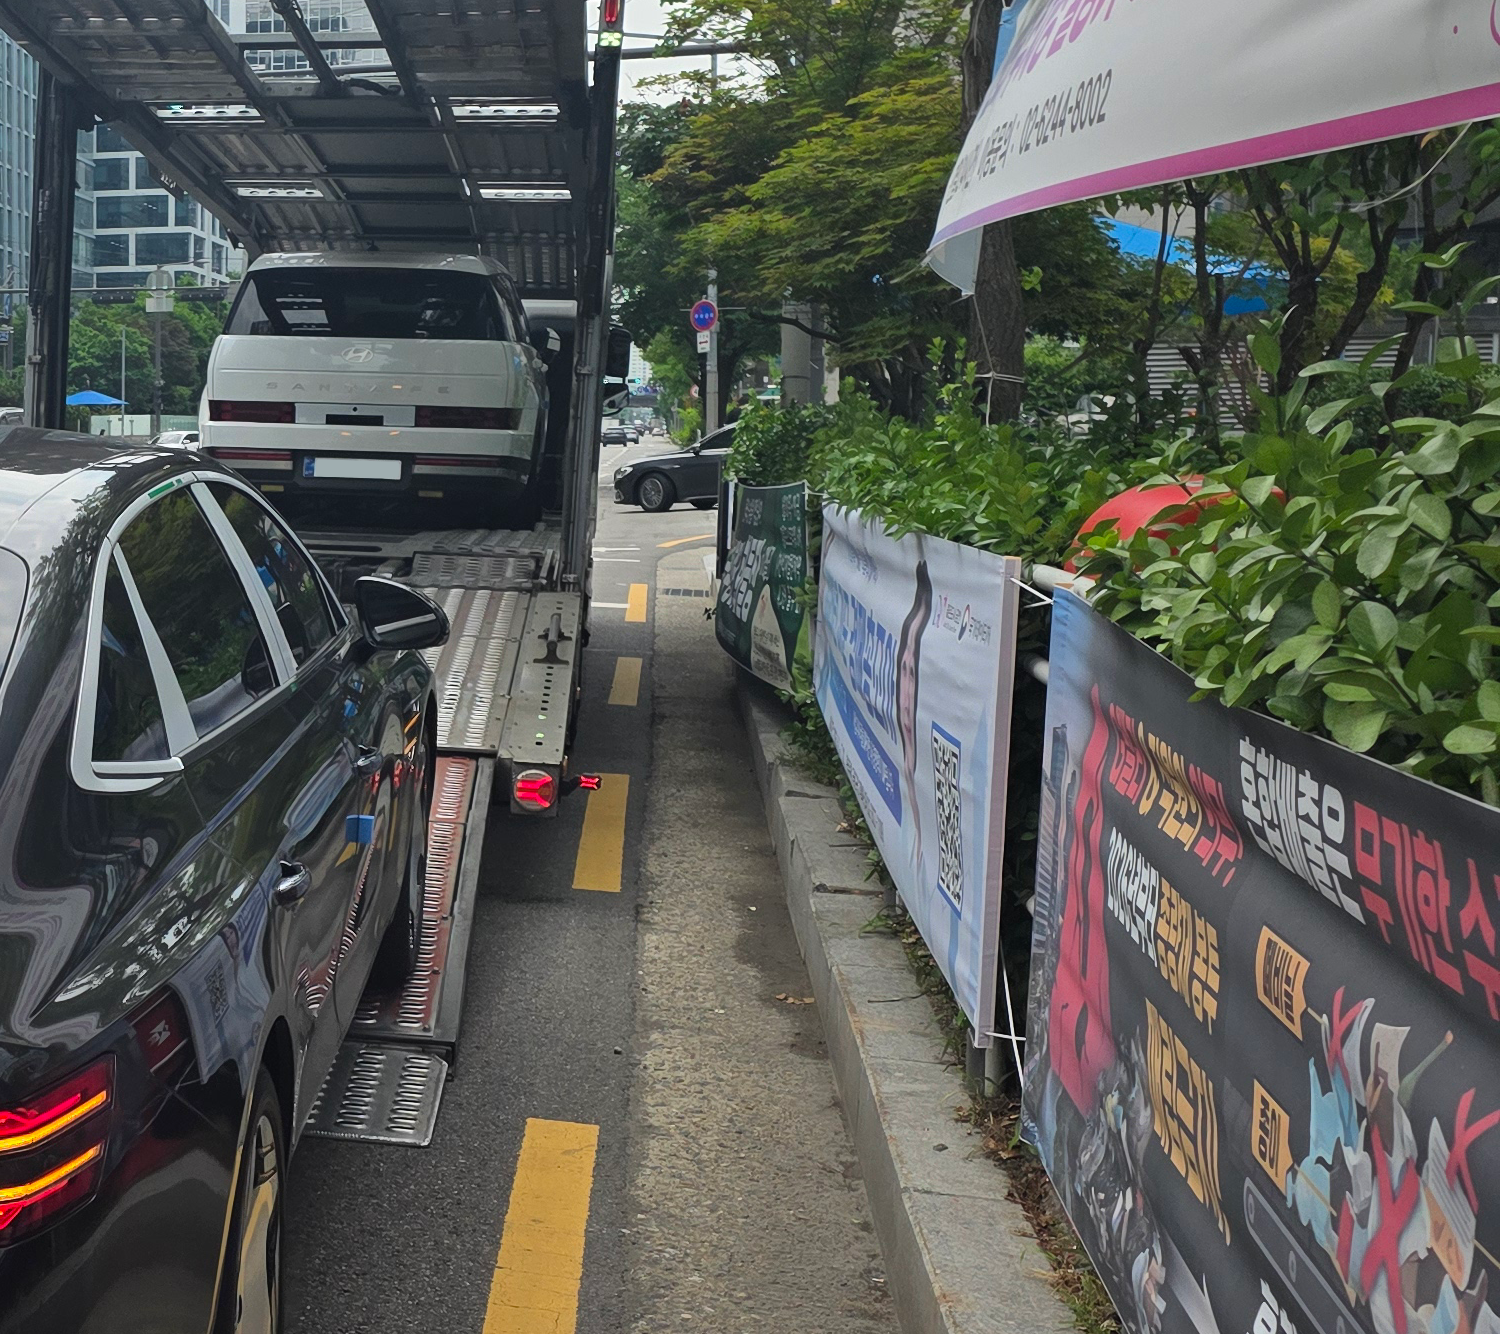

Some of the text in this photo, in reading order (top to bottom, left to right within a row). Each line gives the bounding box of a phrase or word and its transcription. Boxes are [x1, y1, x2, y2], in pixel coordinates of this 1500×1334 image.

[1018, 68, 1113, 156] 02-6244-8002
[1239, 736, 1500, 1022] 혼합배출은 무기한 수
[1258, 1093, 1281, 1179] 종이
